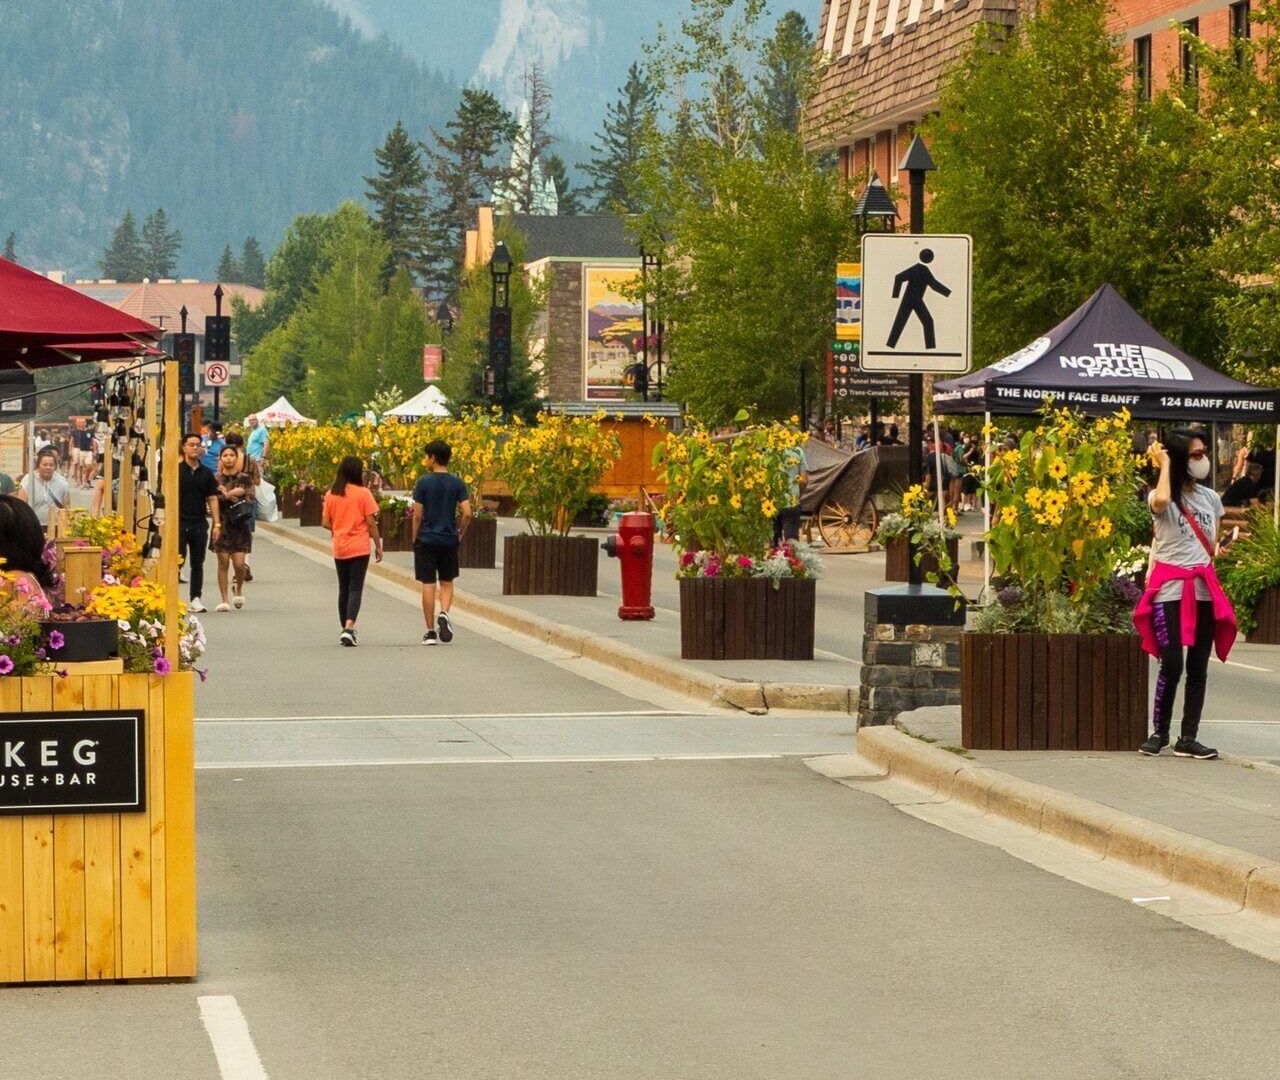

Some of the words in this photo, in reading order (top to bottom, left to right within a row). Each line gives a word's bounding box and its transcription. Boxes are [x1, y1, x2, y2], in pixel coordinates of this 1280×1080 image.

[1093, 343, 1140, 357] THE
[1059, 356, 1143, 369] NORTH
[1086, 368, 1148, 378] FACE
[997, 388, 1020, 398] THE
[1068, 392, 1098, 403] FACE
[1101, 393, 1140, 405] BANFF
[1160, 396, 1181, 407] 124
[1184, 397, 1223, 409] BANFF
[1226, 399, 1274, 411] AVENUE
[5, 739, 97, 767] KEG
